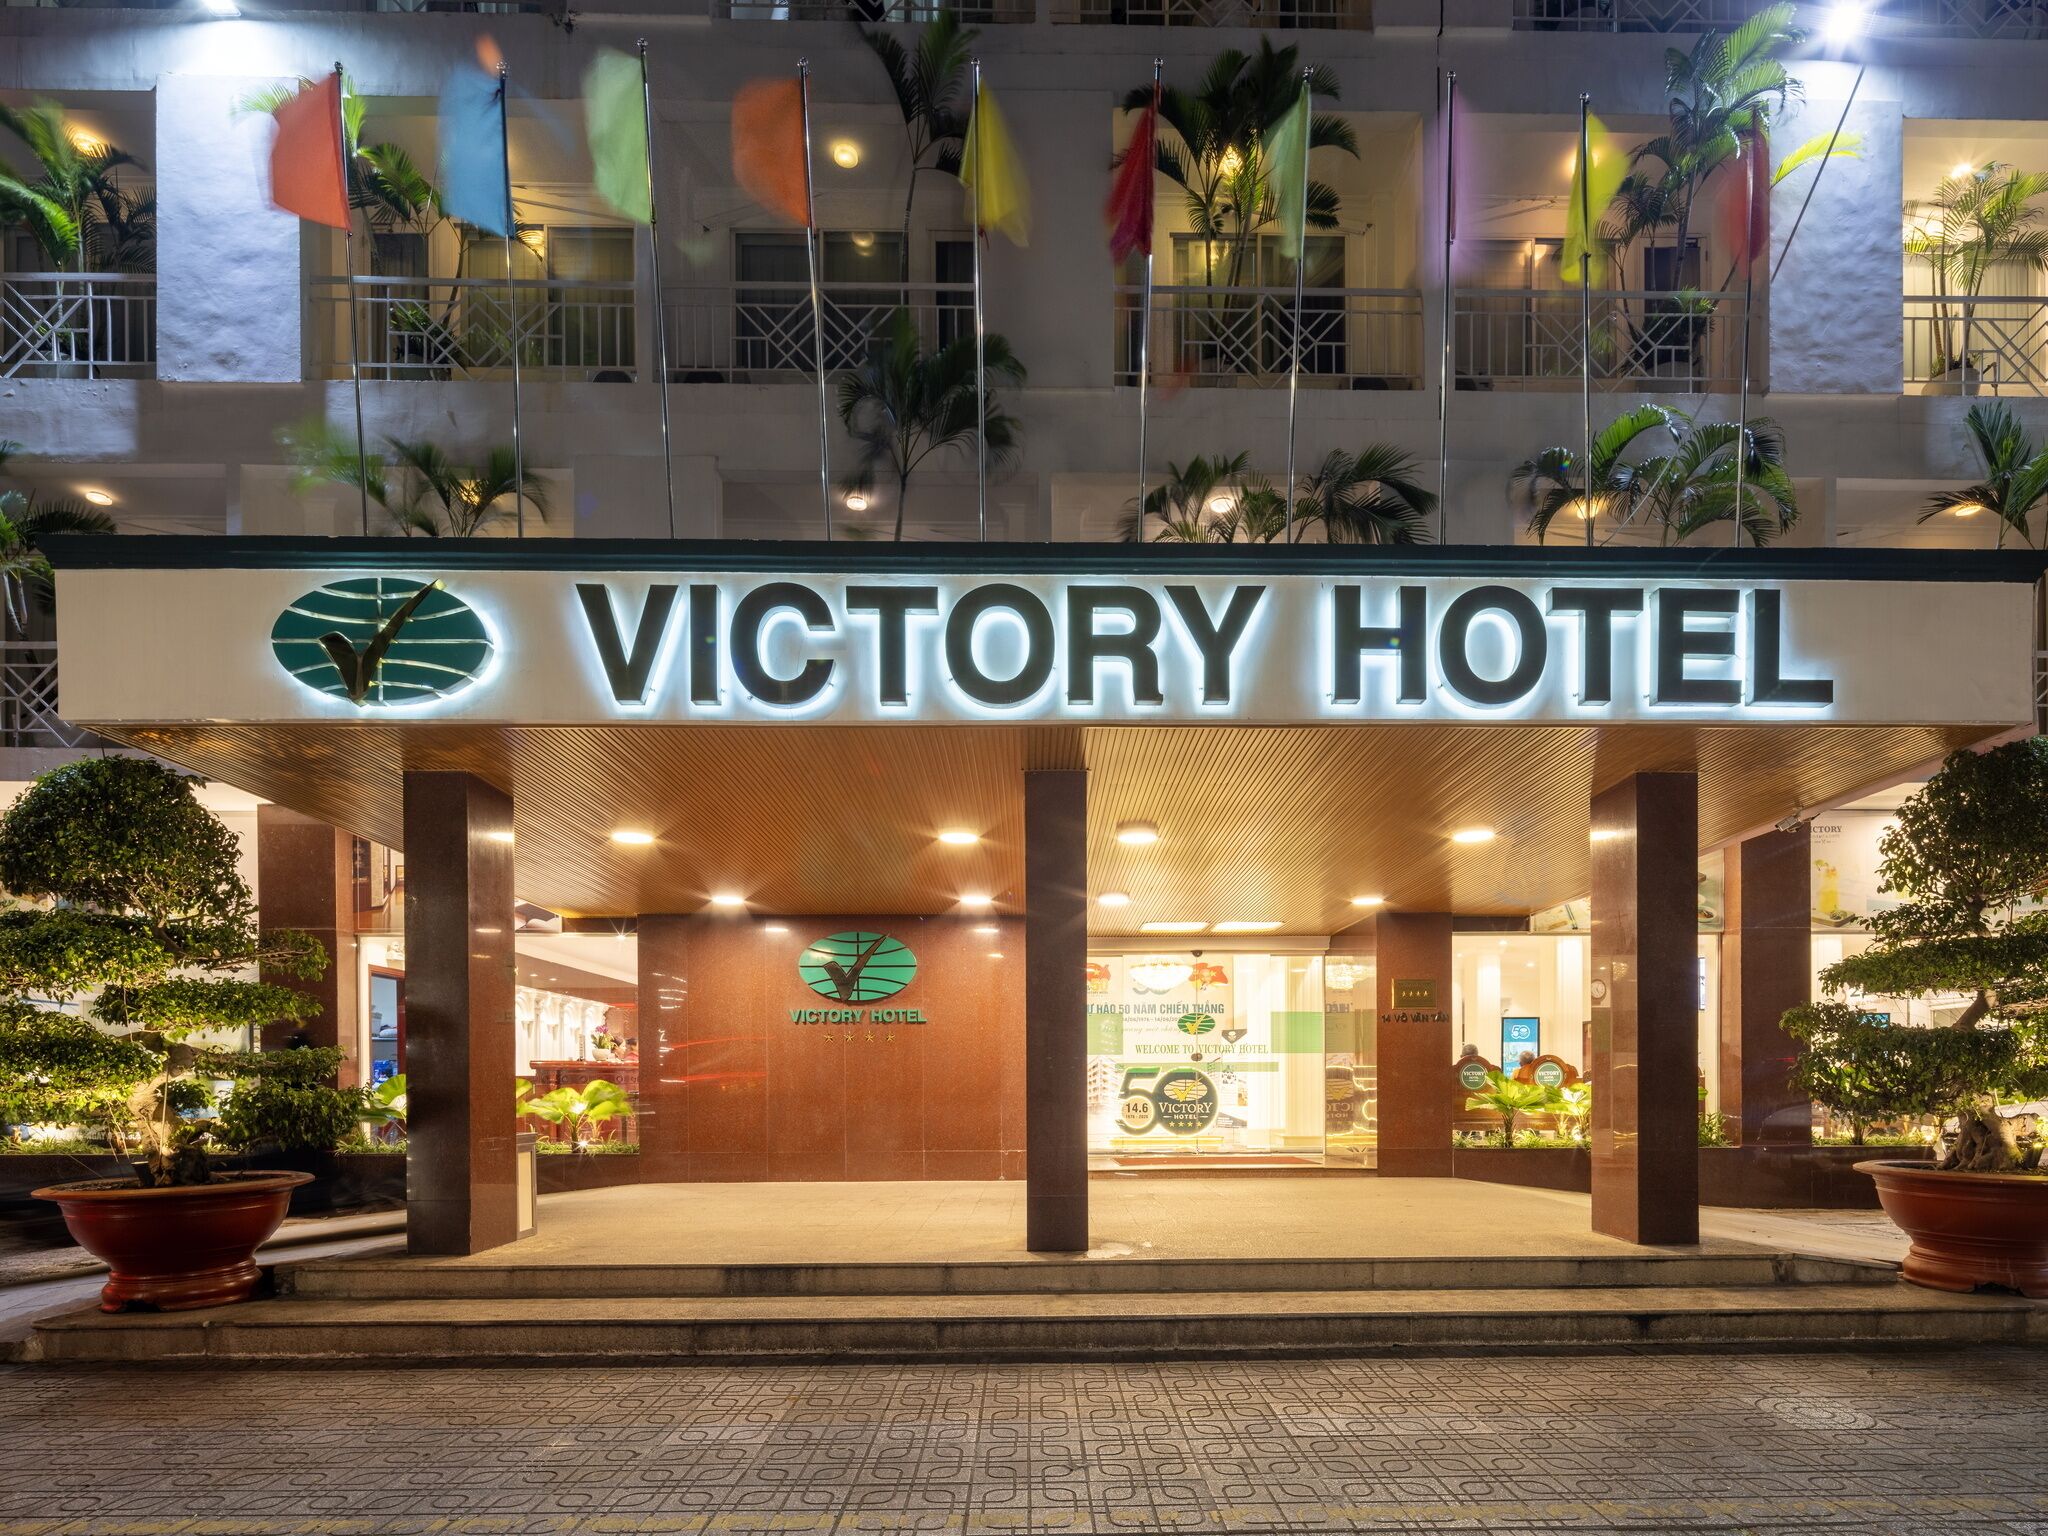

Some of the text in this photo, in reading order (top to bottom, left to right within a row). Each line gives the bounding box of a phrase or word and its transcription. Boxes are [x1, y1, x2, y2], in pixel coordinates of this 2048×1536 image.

[576, 583, 1835, 703] VICTORY HOTEL
[1811, 825, 1842, 833] CTORY
[1086, 1001, 1097, 1016] Ự
[1097, 1001, 1116, 1014] HÀO
[1119, 1004, 1131, 1014] 50
[1159, 1000, 1190, 1014] CHIẾN
[789, 1008, 927, 1024] VICTORY HOTEL
[1135, 1044, 1269, 1054] WELCOME TO VICTORY HOTEL
[1126, 1102, 1148, 1113] 14.6
[1158, 1102, 1213, 1113] VICTORY
